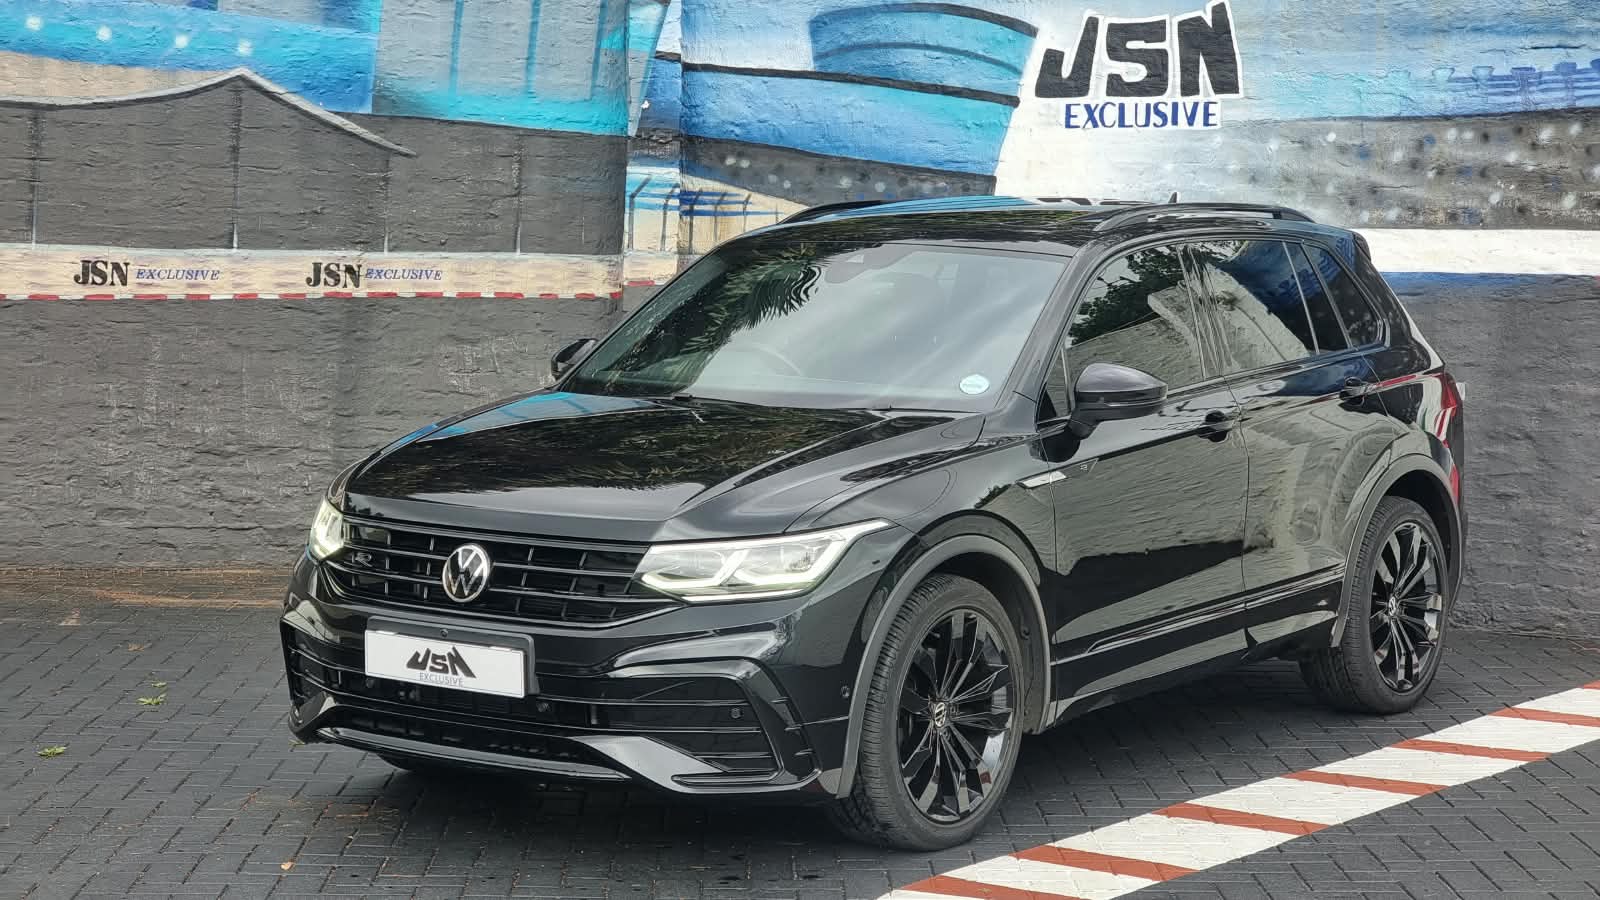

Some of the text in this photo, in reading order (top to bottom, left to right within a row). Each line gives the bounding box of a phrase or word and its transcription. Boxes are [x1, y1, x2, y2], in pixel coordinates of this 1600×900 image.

[1034, 2, 1240, 98] JSN
[1064, 101, 1219, 129] EXCLUSIVE
[73, 260, 221, 287] JSN EXCLUSIVE
[305, 262, 443, 289] JSN EXCLUSIVE
[406, 646, 477, 679] JSN
[419, 672, 464, 687] EXCLUSIVE
